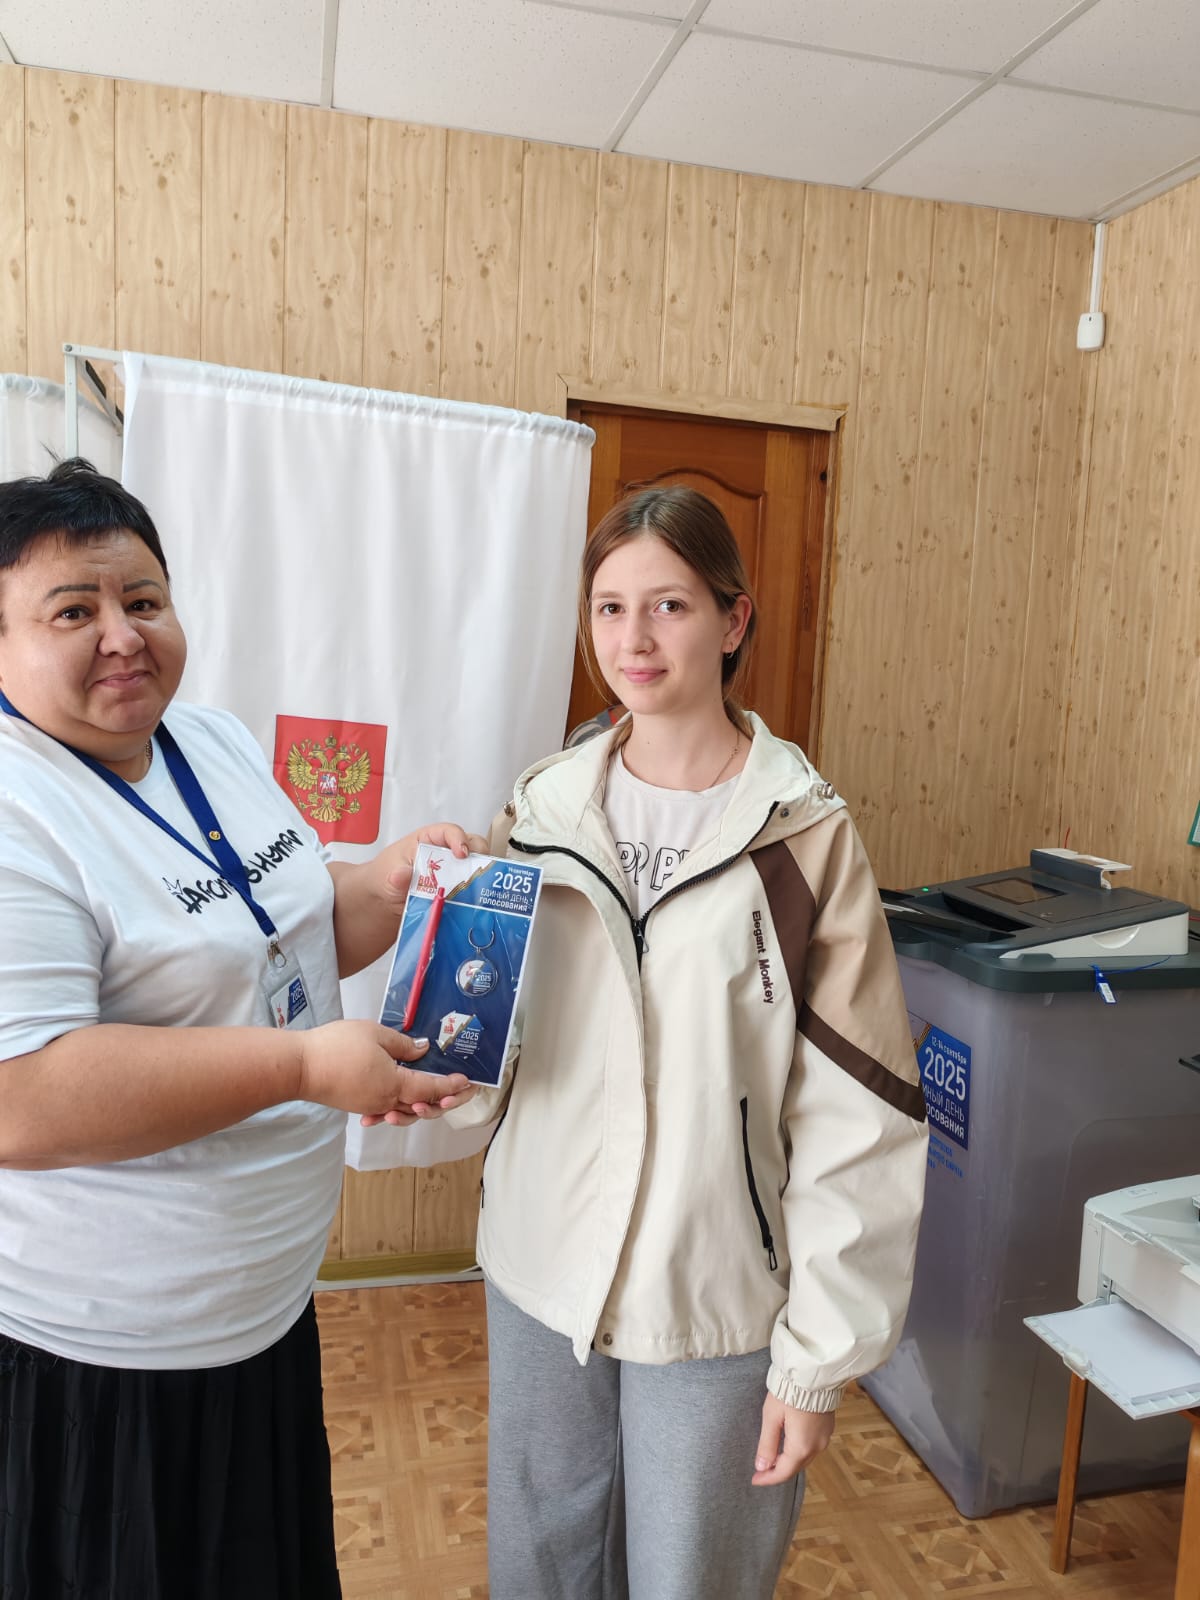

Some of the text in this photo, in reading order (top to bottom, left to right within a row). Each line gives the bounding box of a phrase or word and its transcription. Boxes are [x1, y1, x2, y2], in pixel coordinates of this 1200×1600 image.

[480, 888, 529, 905] ЕДИНЫЙ ДЕНЬ
[492, 871, 533, 894] 2025
[752, 910, 774, 1004] Elegant Monkey
[460, 1030, 479, 1041] 2025
[924, 1046, 966, 1101] 2025
[923, 1082, 965, 1123] ИНЫЙ ДЕНЬ
[926, 1102, 965, 1139] осования
